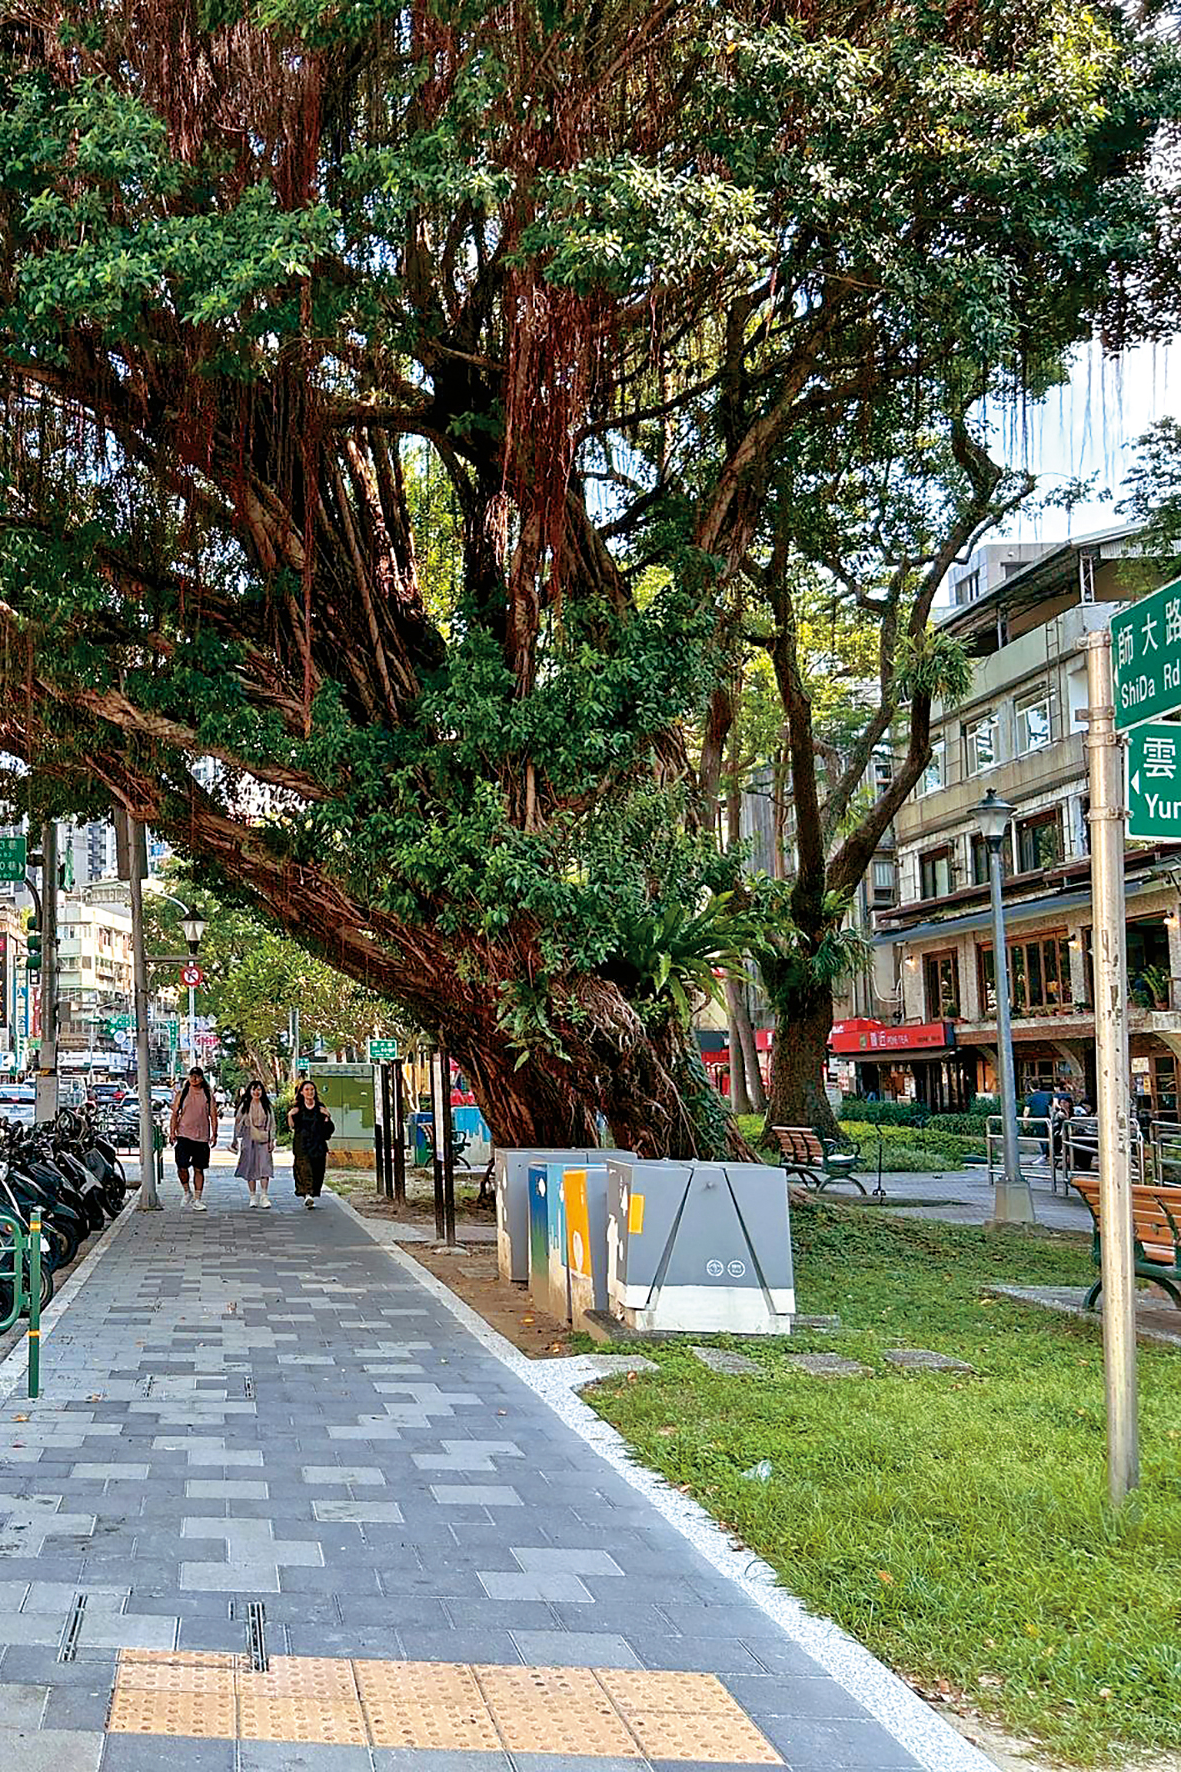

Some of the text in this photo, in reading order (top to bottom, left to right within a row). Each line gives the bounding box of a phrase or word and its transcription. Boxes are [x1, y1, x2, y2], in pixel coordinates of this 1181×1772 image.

[1118, 598, 1181, 669] 師大路
[1121, 658, 1180, 708] ShiDa Rd
[1143, 737, 1177, 779] 雲
